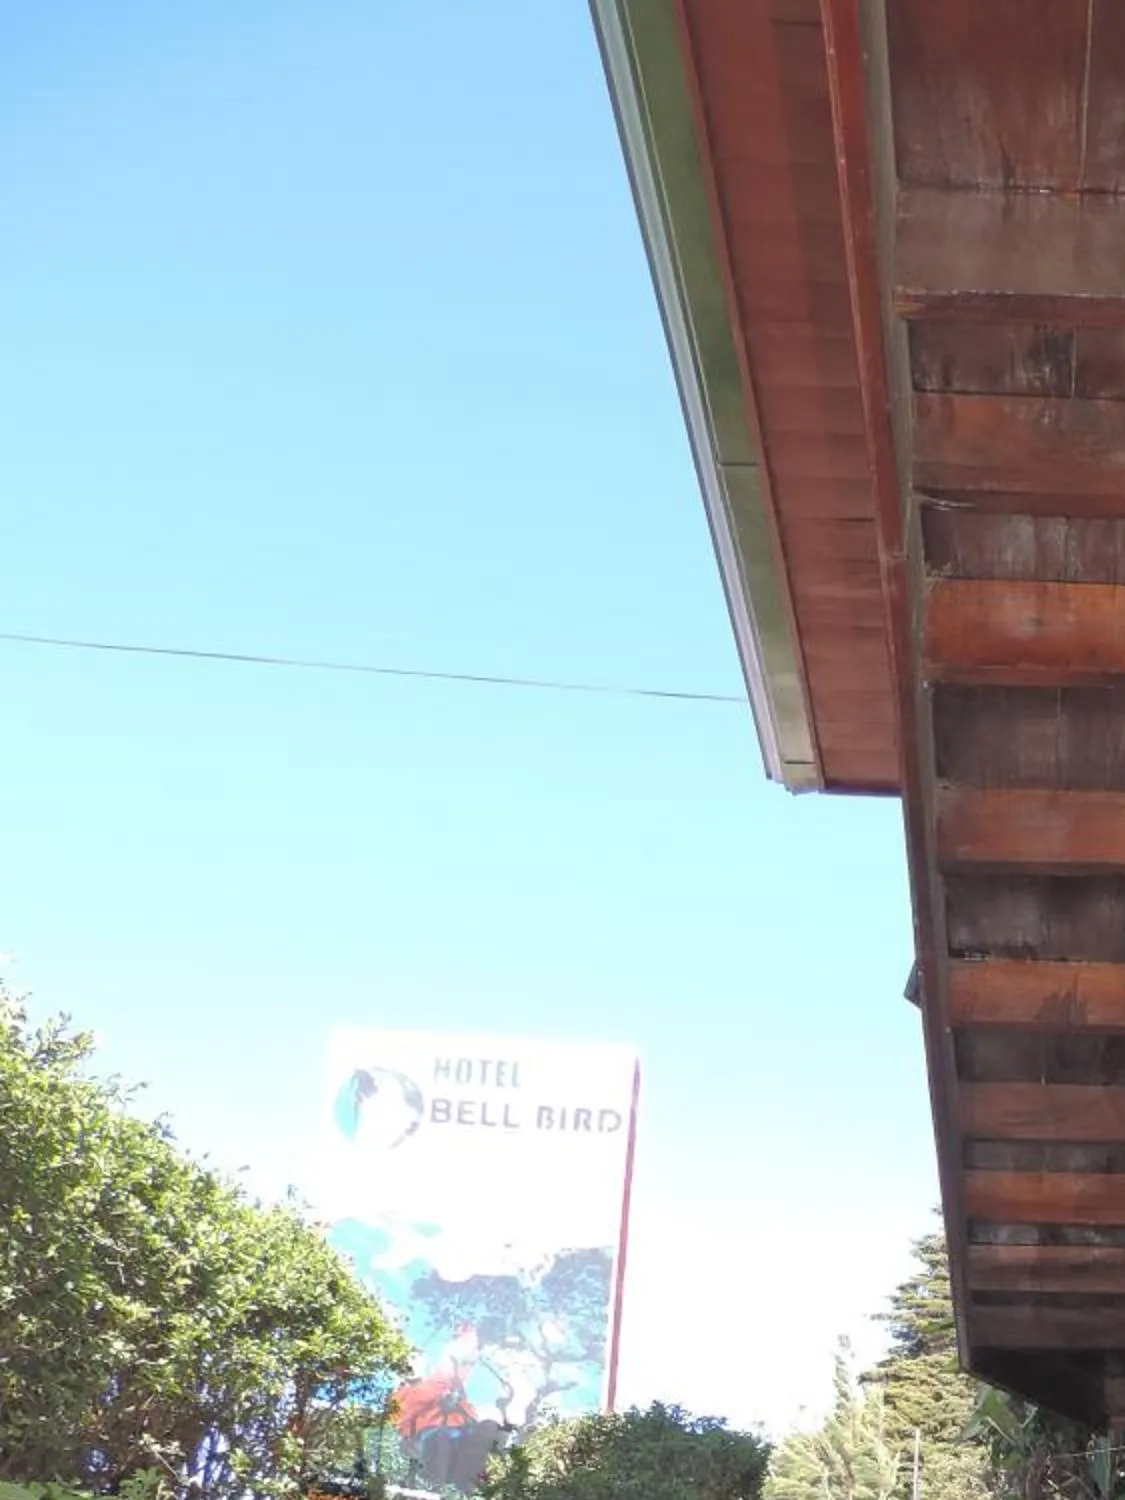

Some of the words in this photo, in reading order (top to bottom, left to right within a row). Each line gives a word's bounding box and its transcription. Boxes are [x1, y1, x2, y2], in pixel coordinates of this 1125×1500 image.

[433, 1056, 521, 1090] HOTEL
[429, 1098, 520, 1130] BELL
[536, 1105, 624, 1134] BIRD
